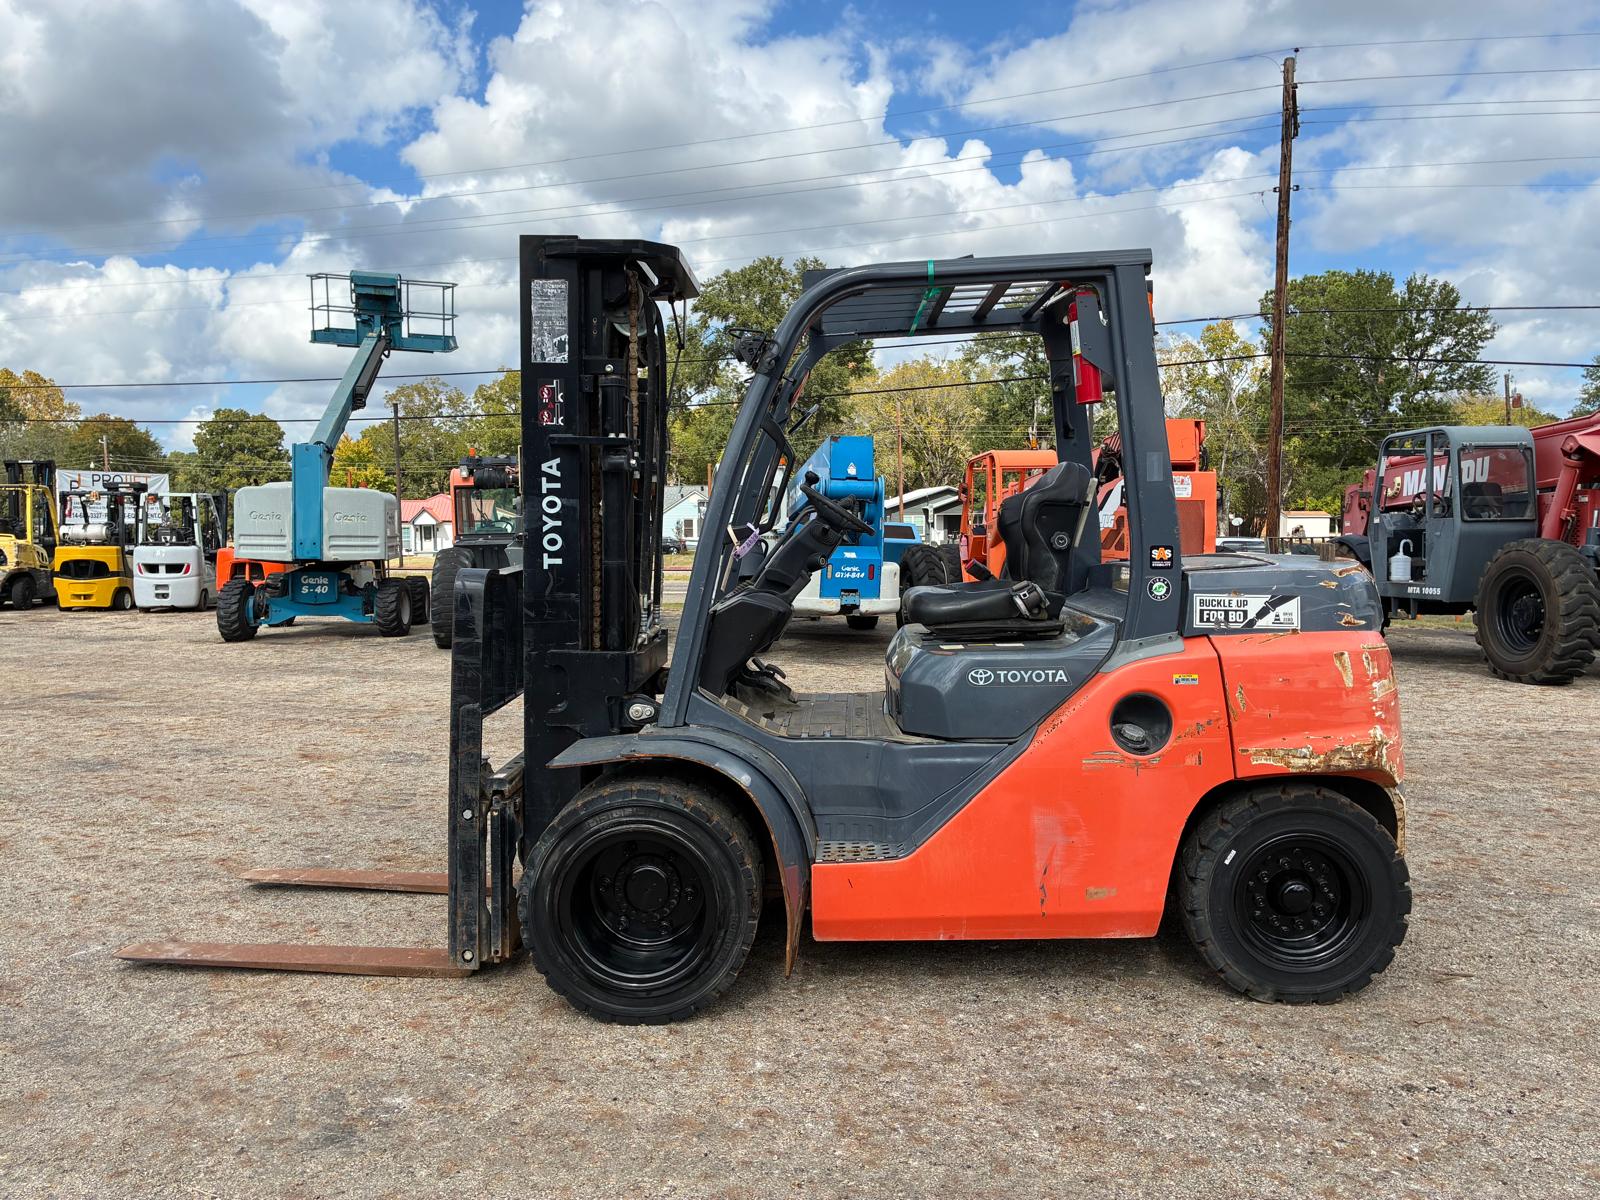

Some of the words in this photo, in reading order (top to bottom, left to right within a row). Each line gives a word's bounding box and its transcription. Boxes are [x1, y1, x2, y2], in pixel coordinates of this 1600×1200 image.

[249, 510, 282, 521] Genie
[333, 511, 368, 522] Genie
[541, 457, 563, 570] TOYOTA
[1151, 547, 1172, 560] SAS
[301, 575, 328, 584] Genie
[1407, 586, 1421, 594] MTA
[1422, 587, 1441, 595] 10055
[1199, 598, 1233, 608] BUCKLE
[1236, 599, 1248, 608] UP
[1203, 610, 1225, 622] FOR
[996, 670, 1068, 683] TOYOTA
